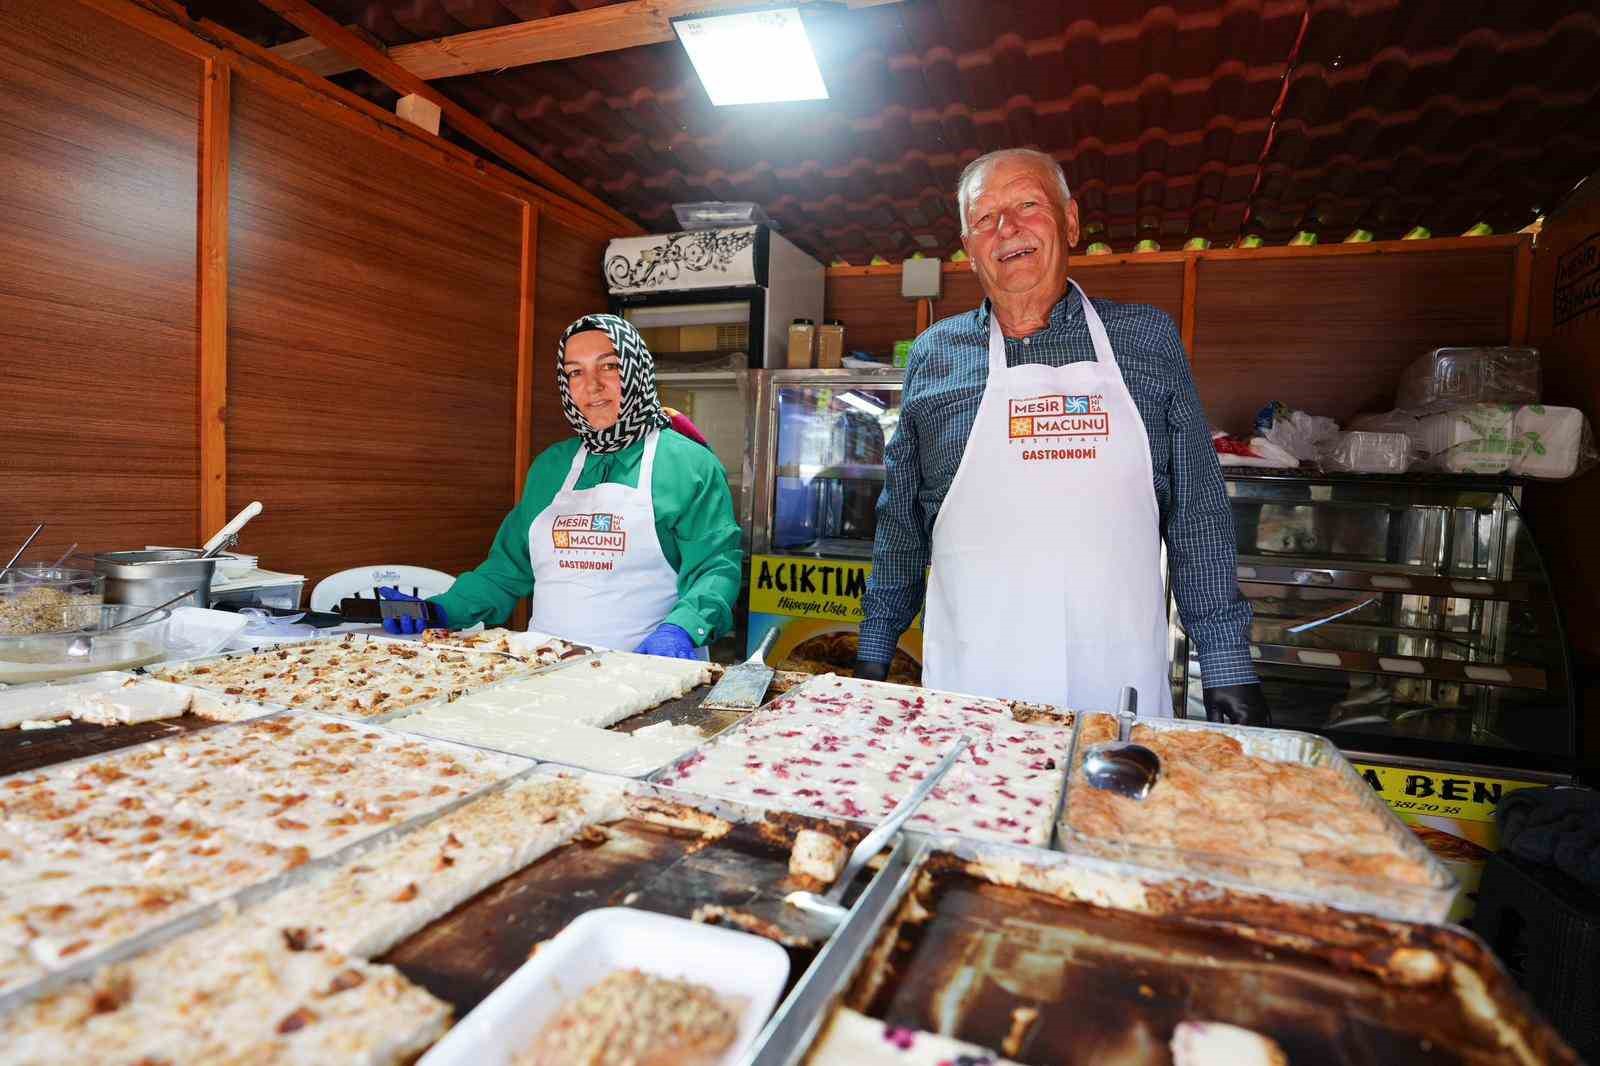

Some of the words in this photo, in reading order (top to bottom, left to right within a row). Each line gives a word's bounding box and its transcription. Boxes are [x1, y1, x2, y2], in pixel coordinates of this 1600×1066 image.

[1014, 400, 1060, 413] MESİR
[1037, 419, 1104, 432] MACUNU
[1022, 446, 1096, 460] GASTRONOMİ
[557, 517, 588, 527] MESİR
[571, 536, 622, 546] MACUNU
[559, 559, 613, 570] GASTRONOMİ
[1404, 775, 1502, 804] BEN
